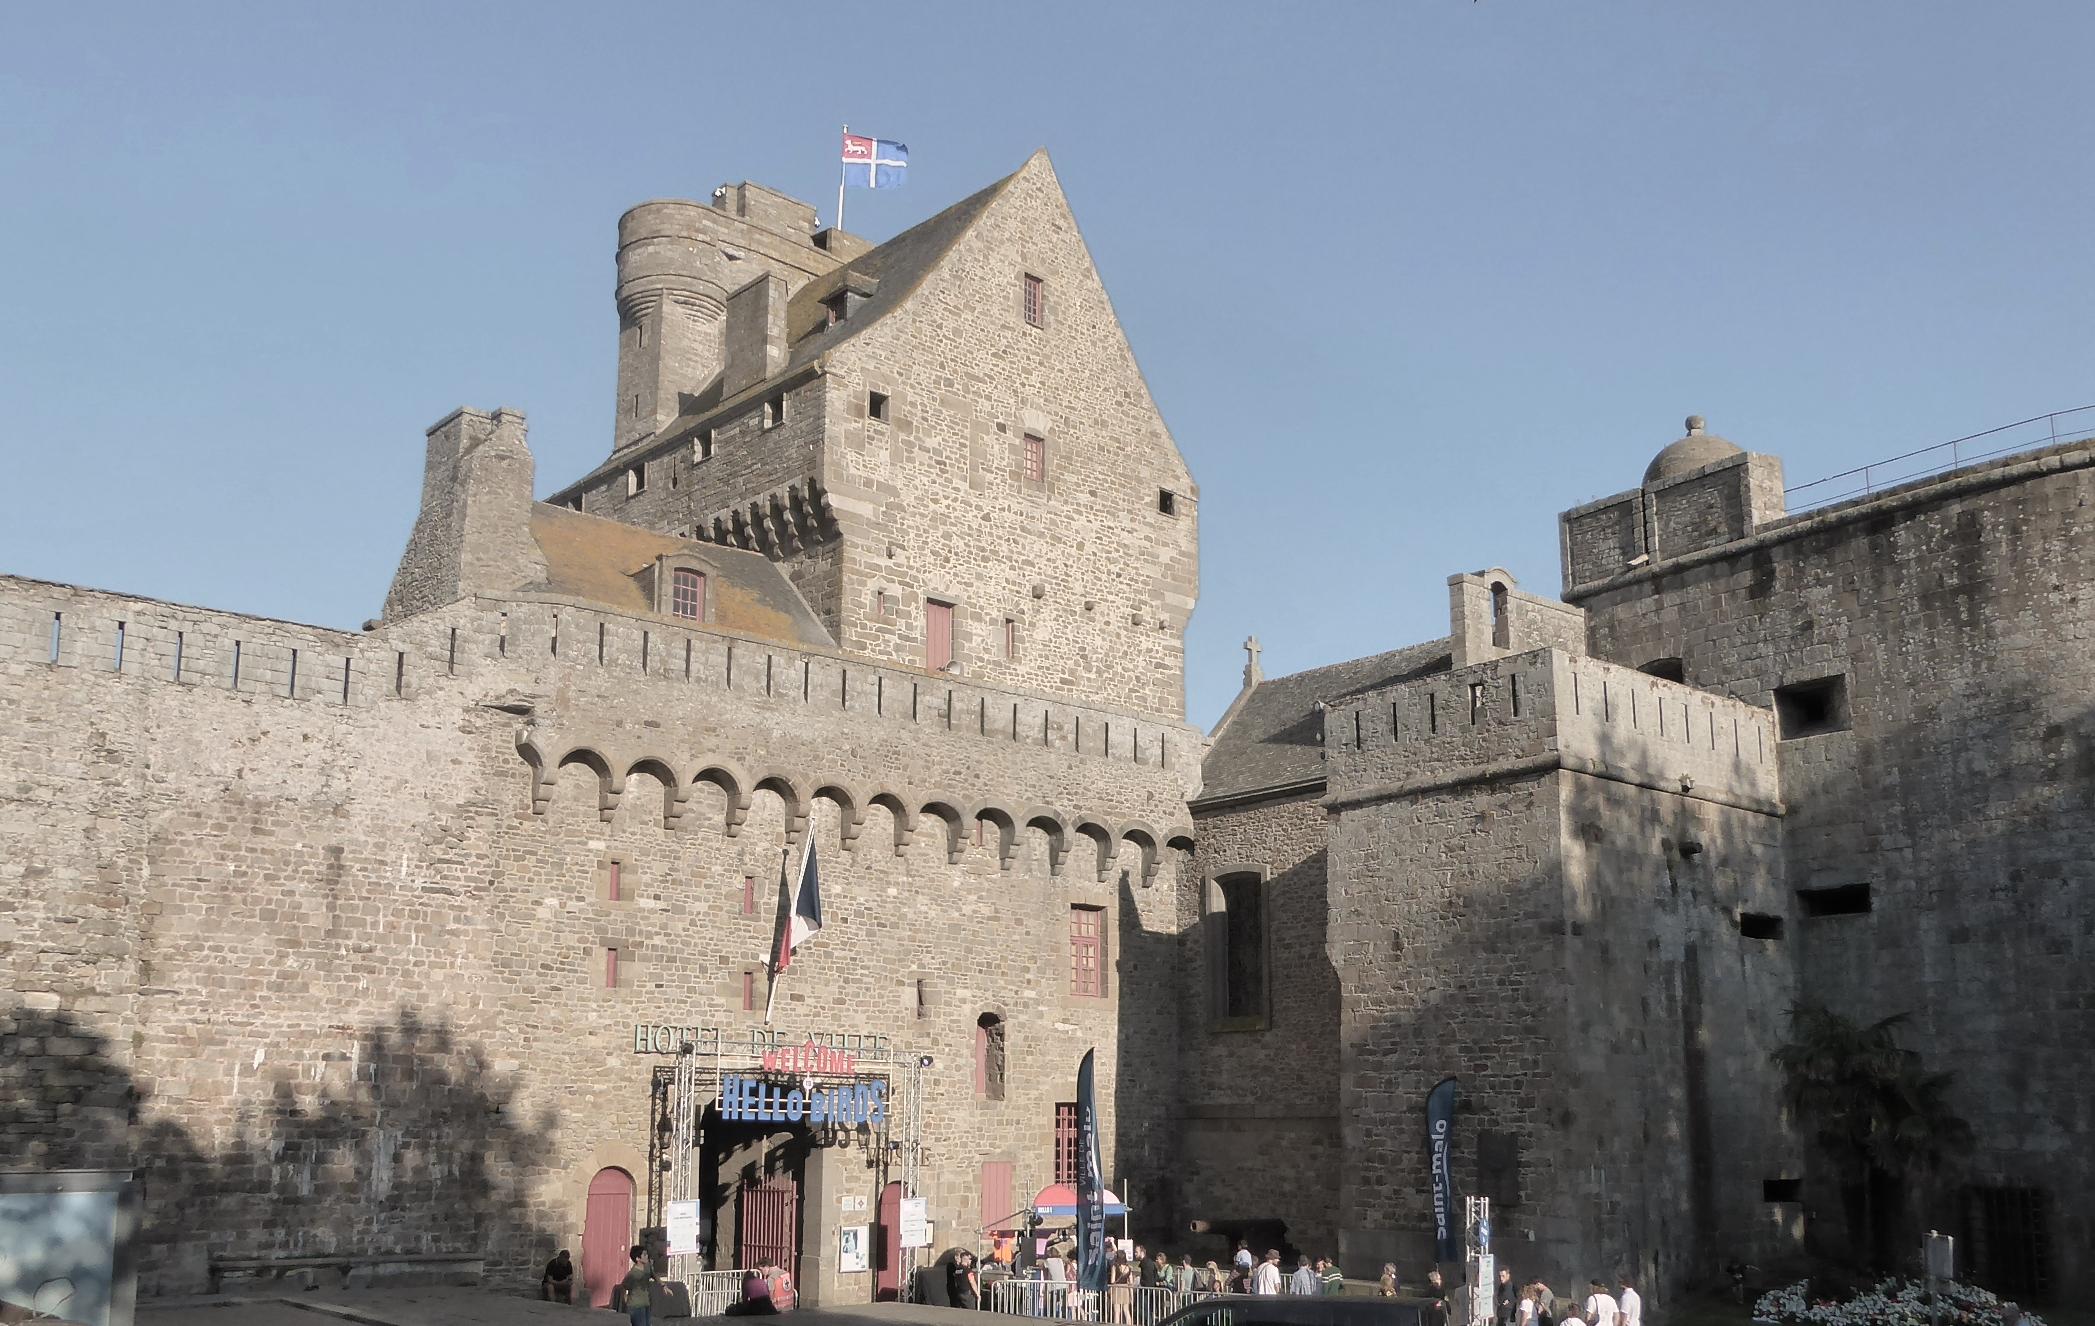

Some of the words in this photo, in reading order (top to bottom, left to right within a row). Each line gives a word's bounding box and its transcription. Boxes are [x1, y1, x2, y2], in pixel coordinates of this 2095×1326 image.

[762, 1040, 856, 1074] WELCOME
[722, 1075, 803, 1121] HELLO
[810, 1079, 884, 1122] BIRDS
